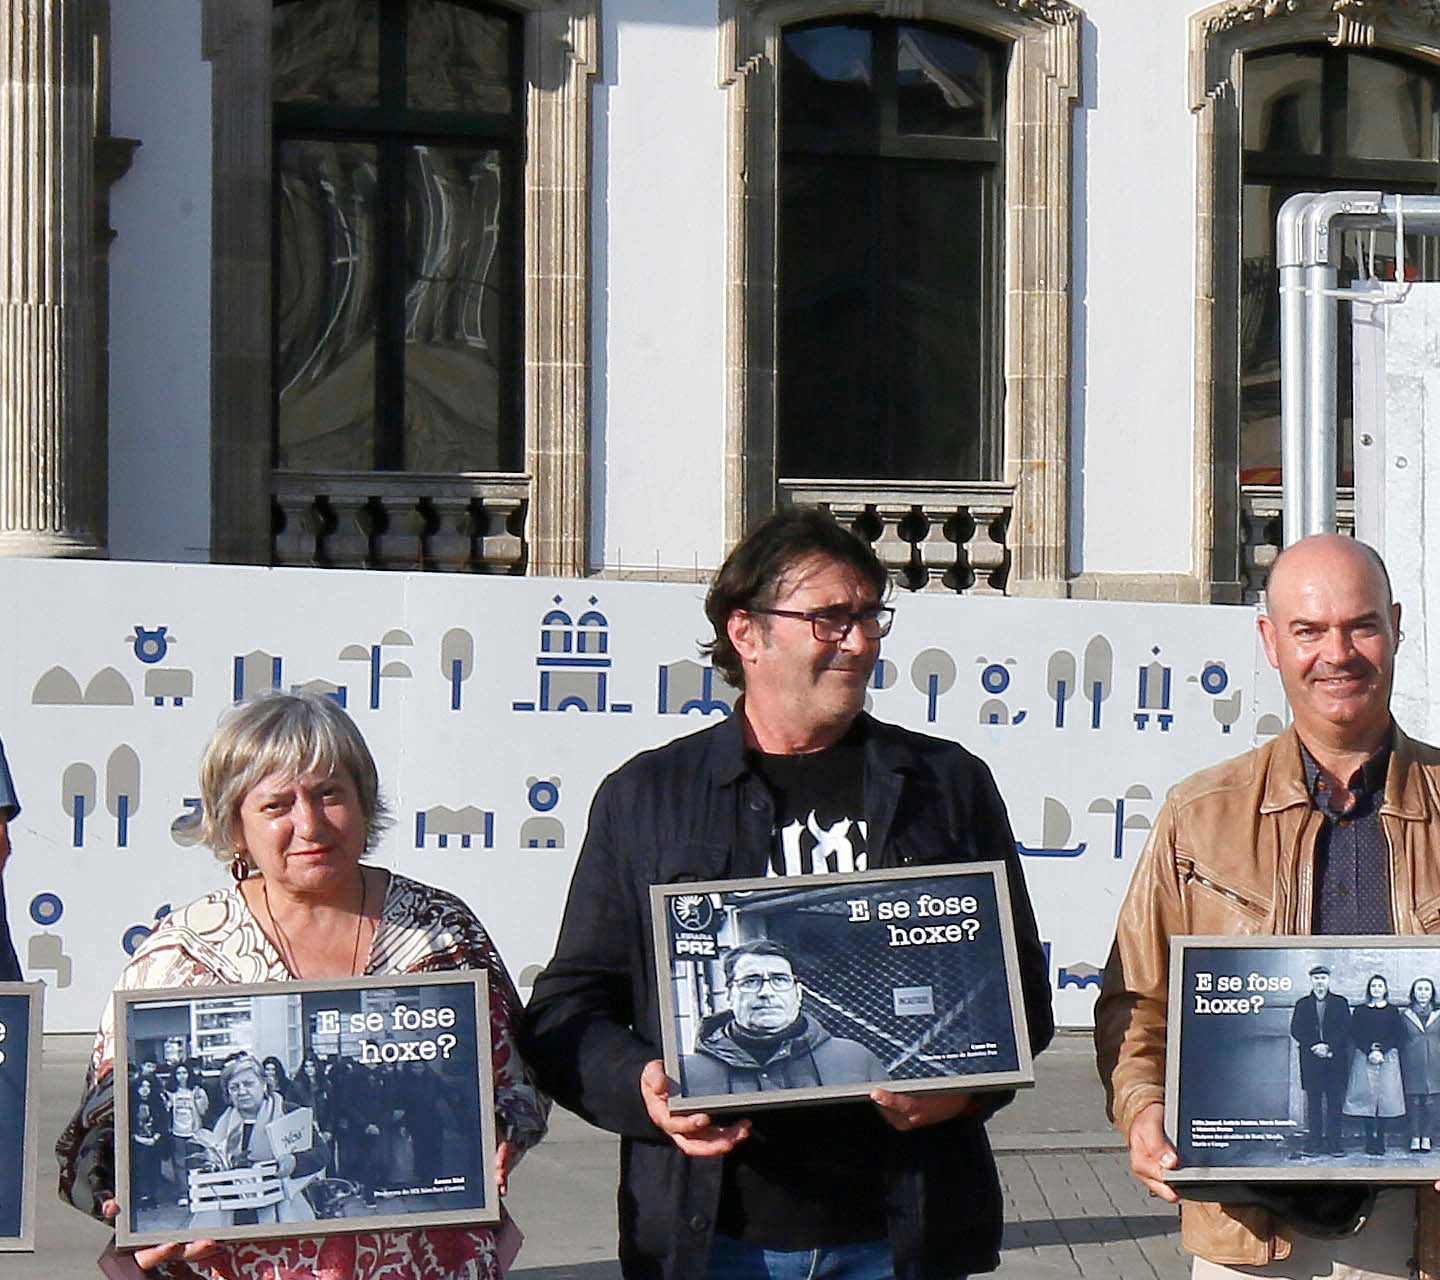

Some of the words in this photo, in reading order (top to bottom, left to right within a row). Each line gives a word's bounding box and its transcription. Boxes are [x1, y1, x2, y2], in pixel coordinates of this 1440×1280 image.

[848, 899, 870, 922] E
[877, 902, 911, 921] se
[916, 895, 978, 918] fose
[887, 919, 980, 947] hoxe?
[676, 941, 716, 955] PAZ
[1194, 973, 1212, 992] E
[1217, 977, 1242, 992] se
[1246, 973, 1292, 992] fose
[1194, 995, 1265, 1015] hoxe?
[317, 1009, 340, 1035] E
[349, 1012, 385, 1034] se
[390, 1006, 456, 1031] fose
[358, 1034, 456, 1064] hoxe?
